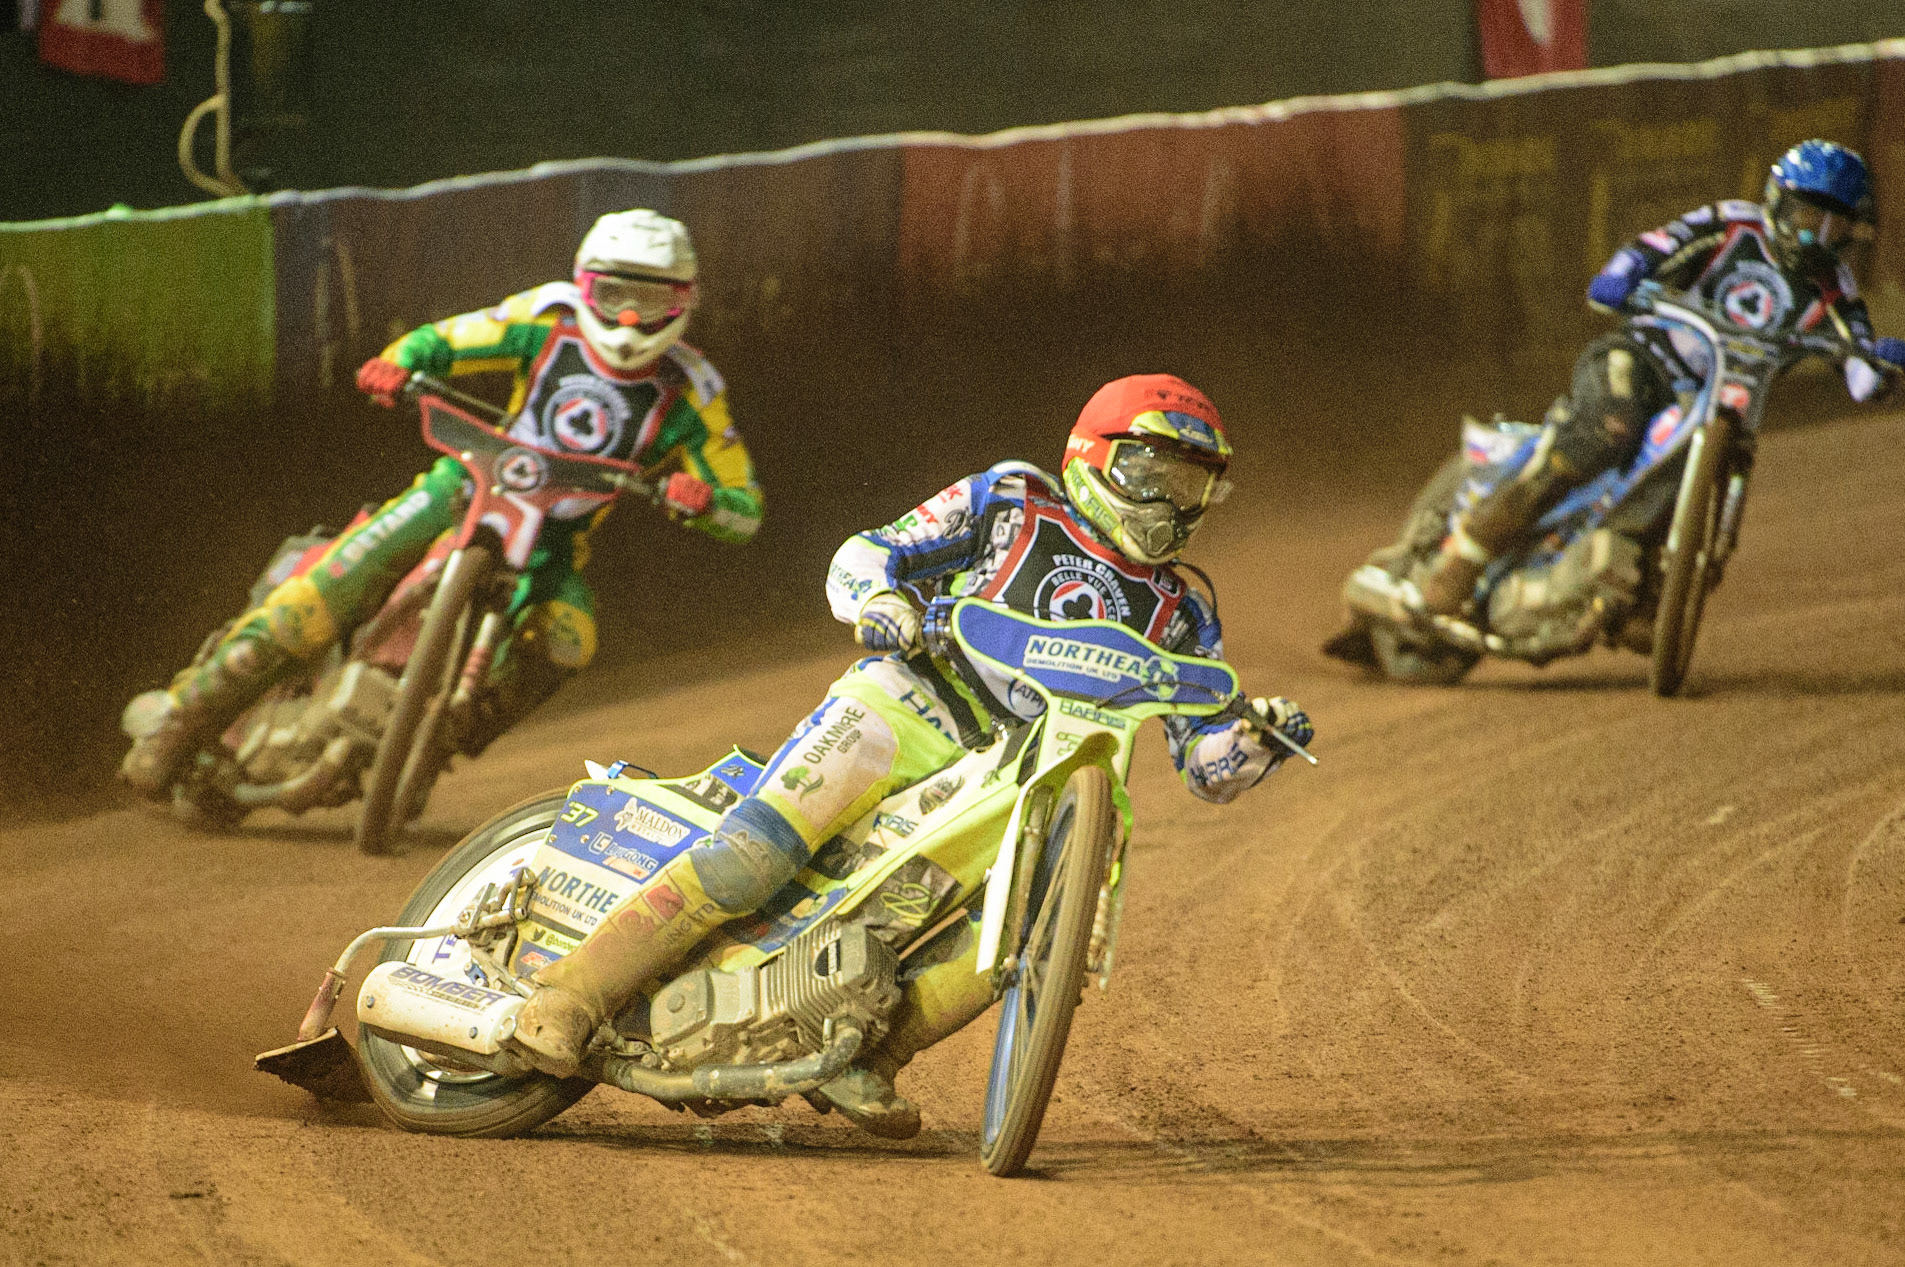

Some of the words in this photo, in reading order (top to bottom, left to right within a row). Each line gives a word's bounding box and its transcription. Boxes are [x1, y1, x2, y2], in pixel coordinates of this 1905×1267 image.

[1050, 570, 1083, 588] BELLE
[1087, 575, 1109, 597] VUE
[1052, 553, 1094, 571] PETER
[1094, 563, 1132, 618] CRAVEN
[1025, 656, 1083, 671] DEMOLITION
[803, 706, 866, 765] OAKMIRE
[837, 729, 863, 755] GROUP
[560, 801, 599, 828] 37
[571, 907, 585, 923] UK
[584, 914, 599, 928] LTD
[390, 967, 507, 1005] BOMBER
